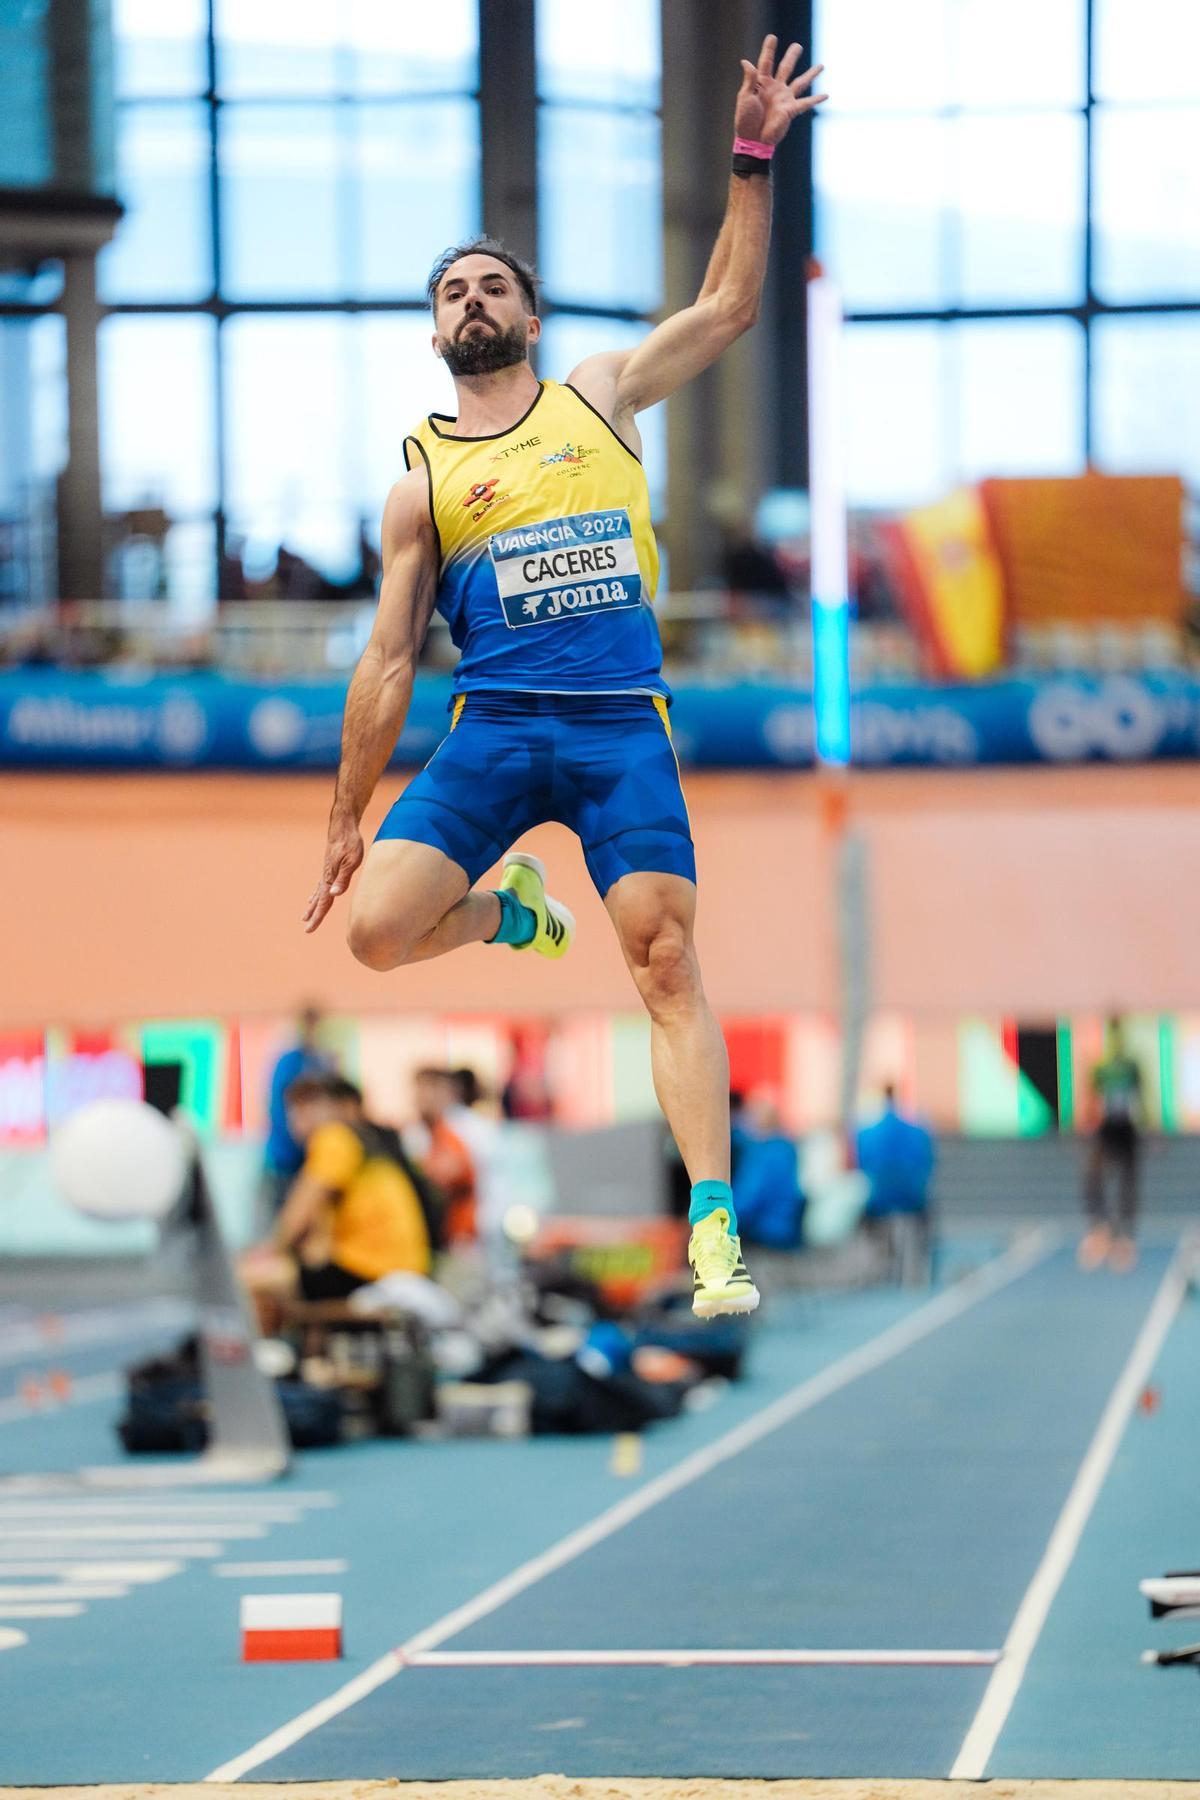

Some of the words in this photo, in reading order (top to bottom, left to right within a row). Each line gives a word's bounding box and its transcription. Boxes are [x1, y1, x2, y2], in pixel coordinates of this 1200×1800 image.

[497, 525, 577, 553] VALENCIA
[582, 516, 623, 537] 2027
[522, 545, 617, 583] CACERES
